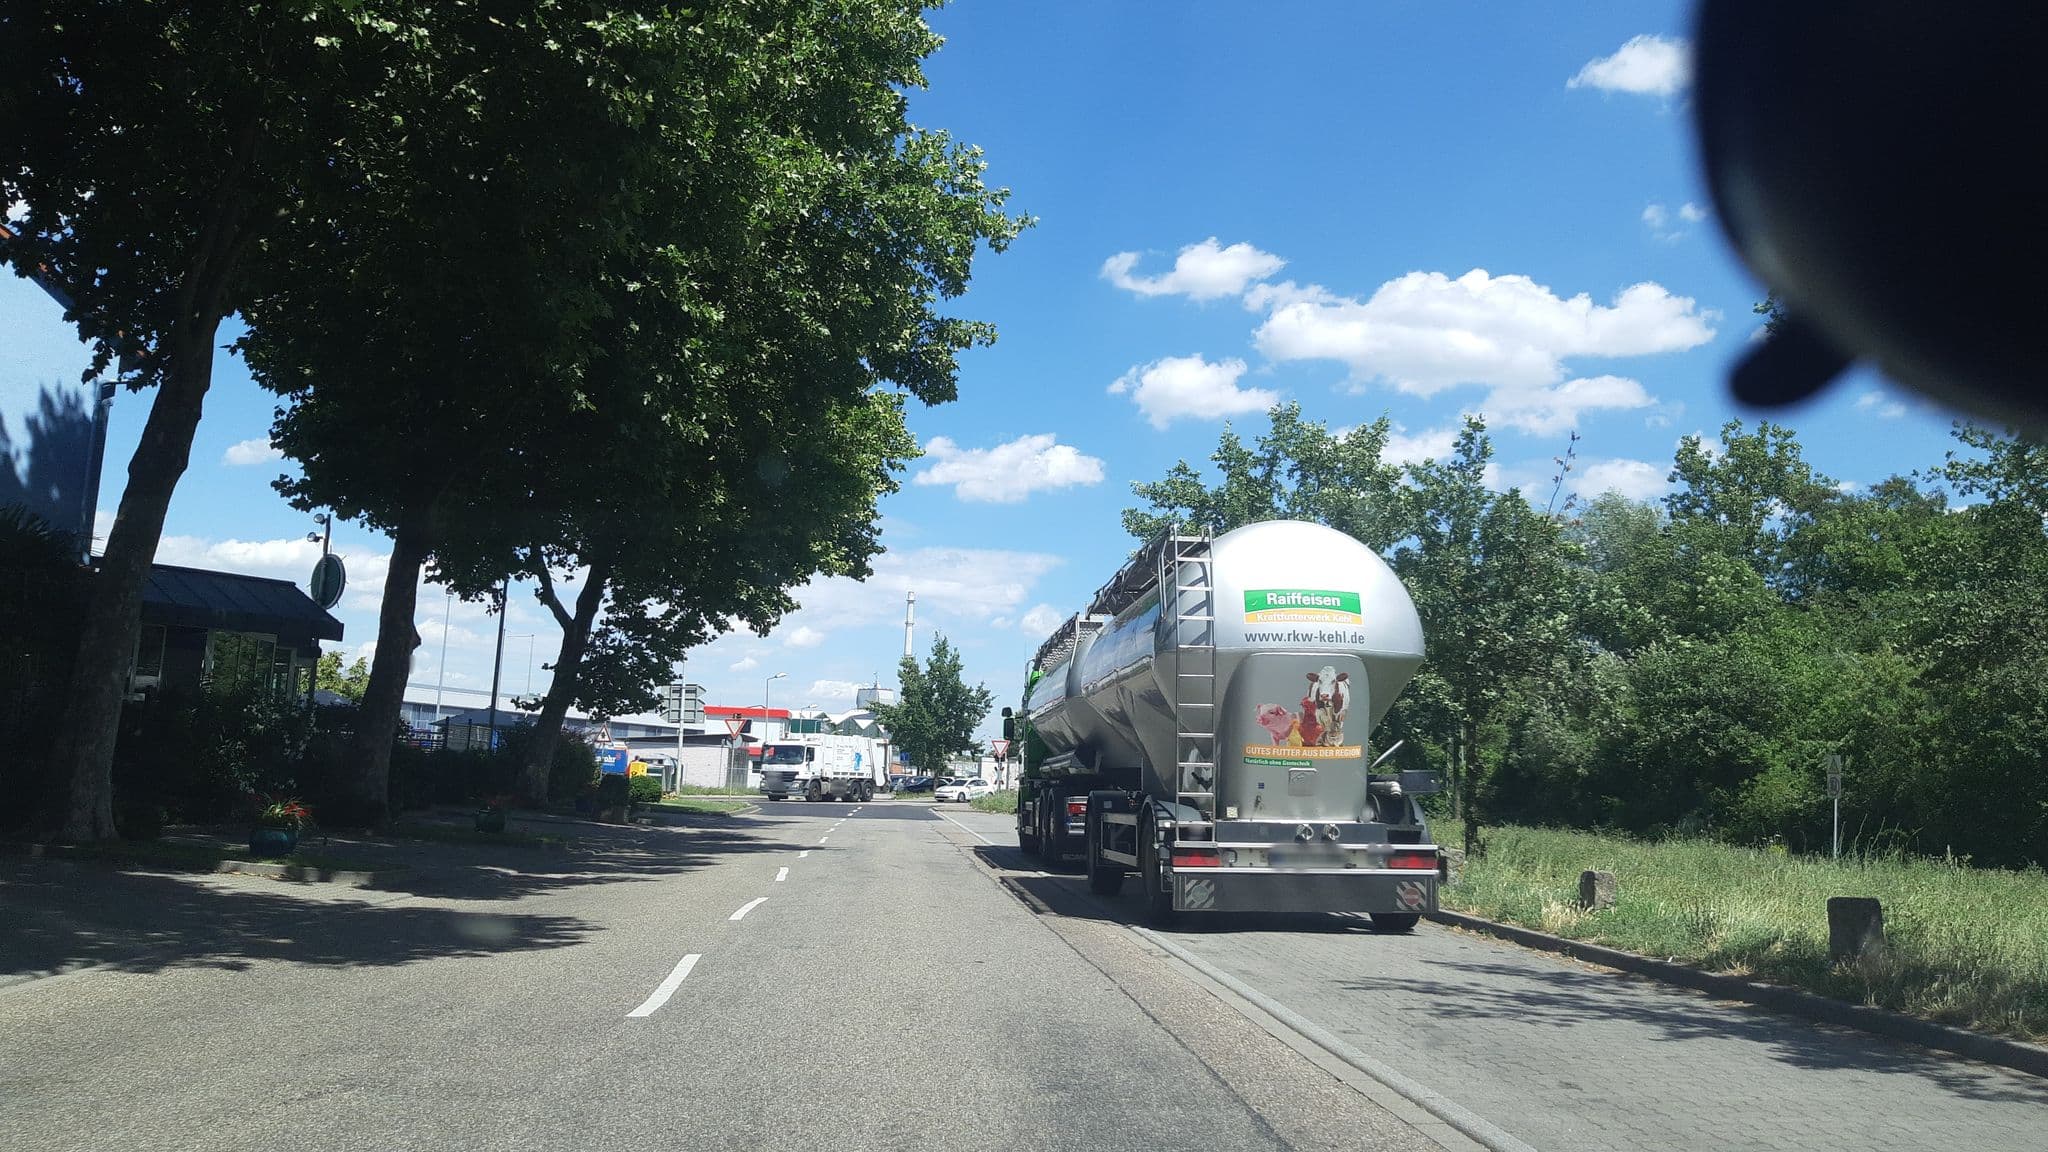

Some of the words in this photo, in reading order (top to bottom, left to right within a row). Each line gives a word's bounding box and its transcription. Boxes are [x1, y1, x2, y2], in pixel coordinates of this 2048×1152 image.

[1266, 592, 1341, 606] Raiffeisen
[1244, 629, 1365, 645] www.rkw-kehl.de
[1245, 746, 1271, 755] GUTES
[1272, 747, 1301, 756] FUTTER
[1302, 748, 1318, 757] AUS
[1319, 748, 1334, 757] DER
[1335, 747, 1361, 757] REGION
